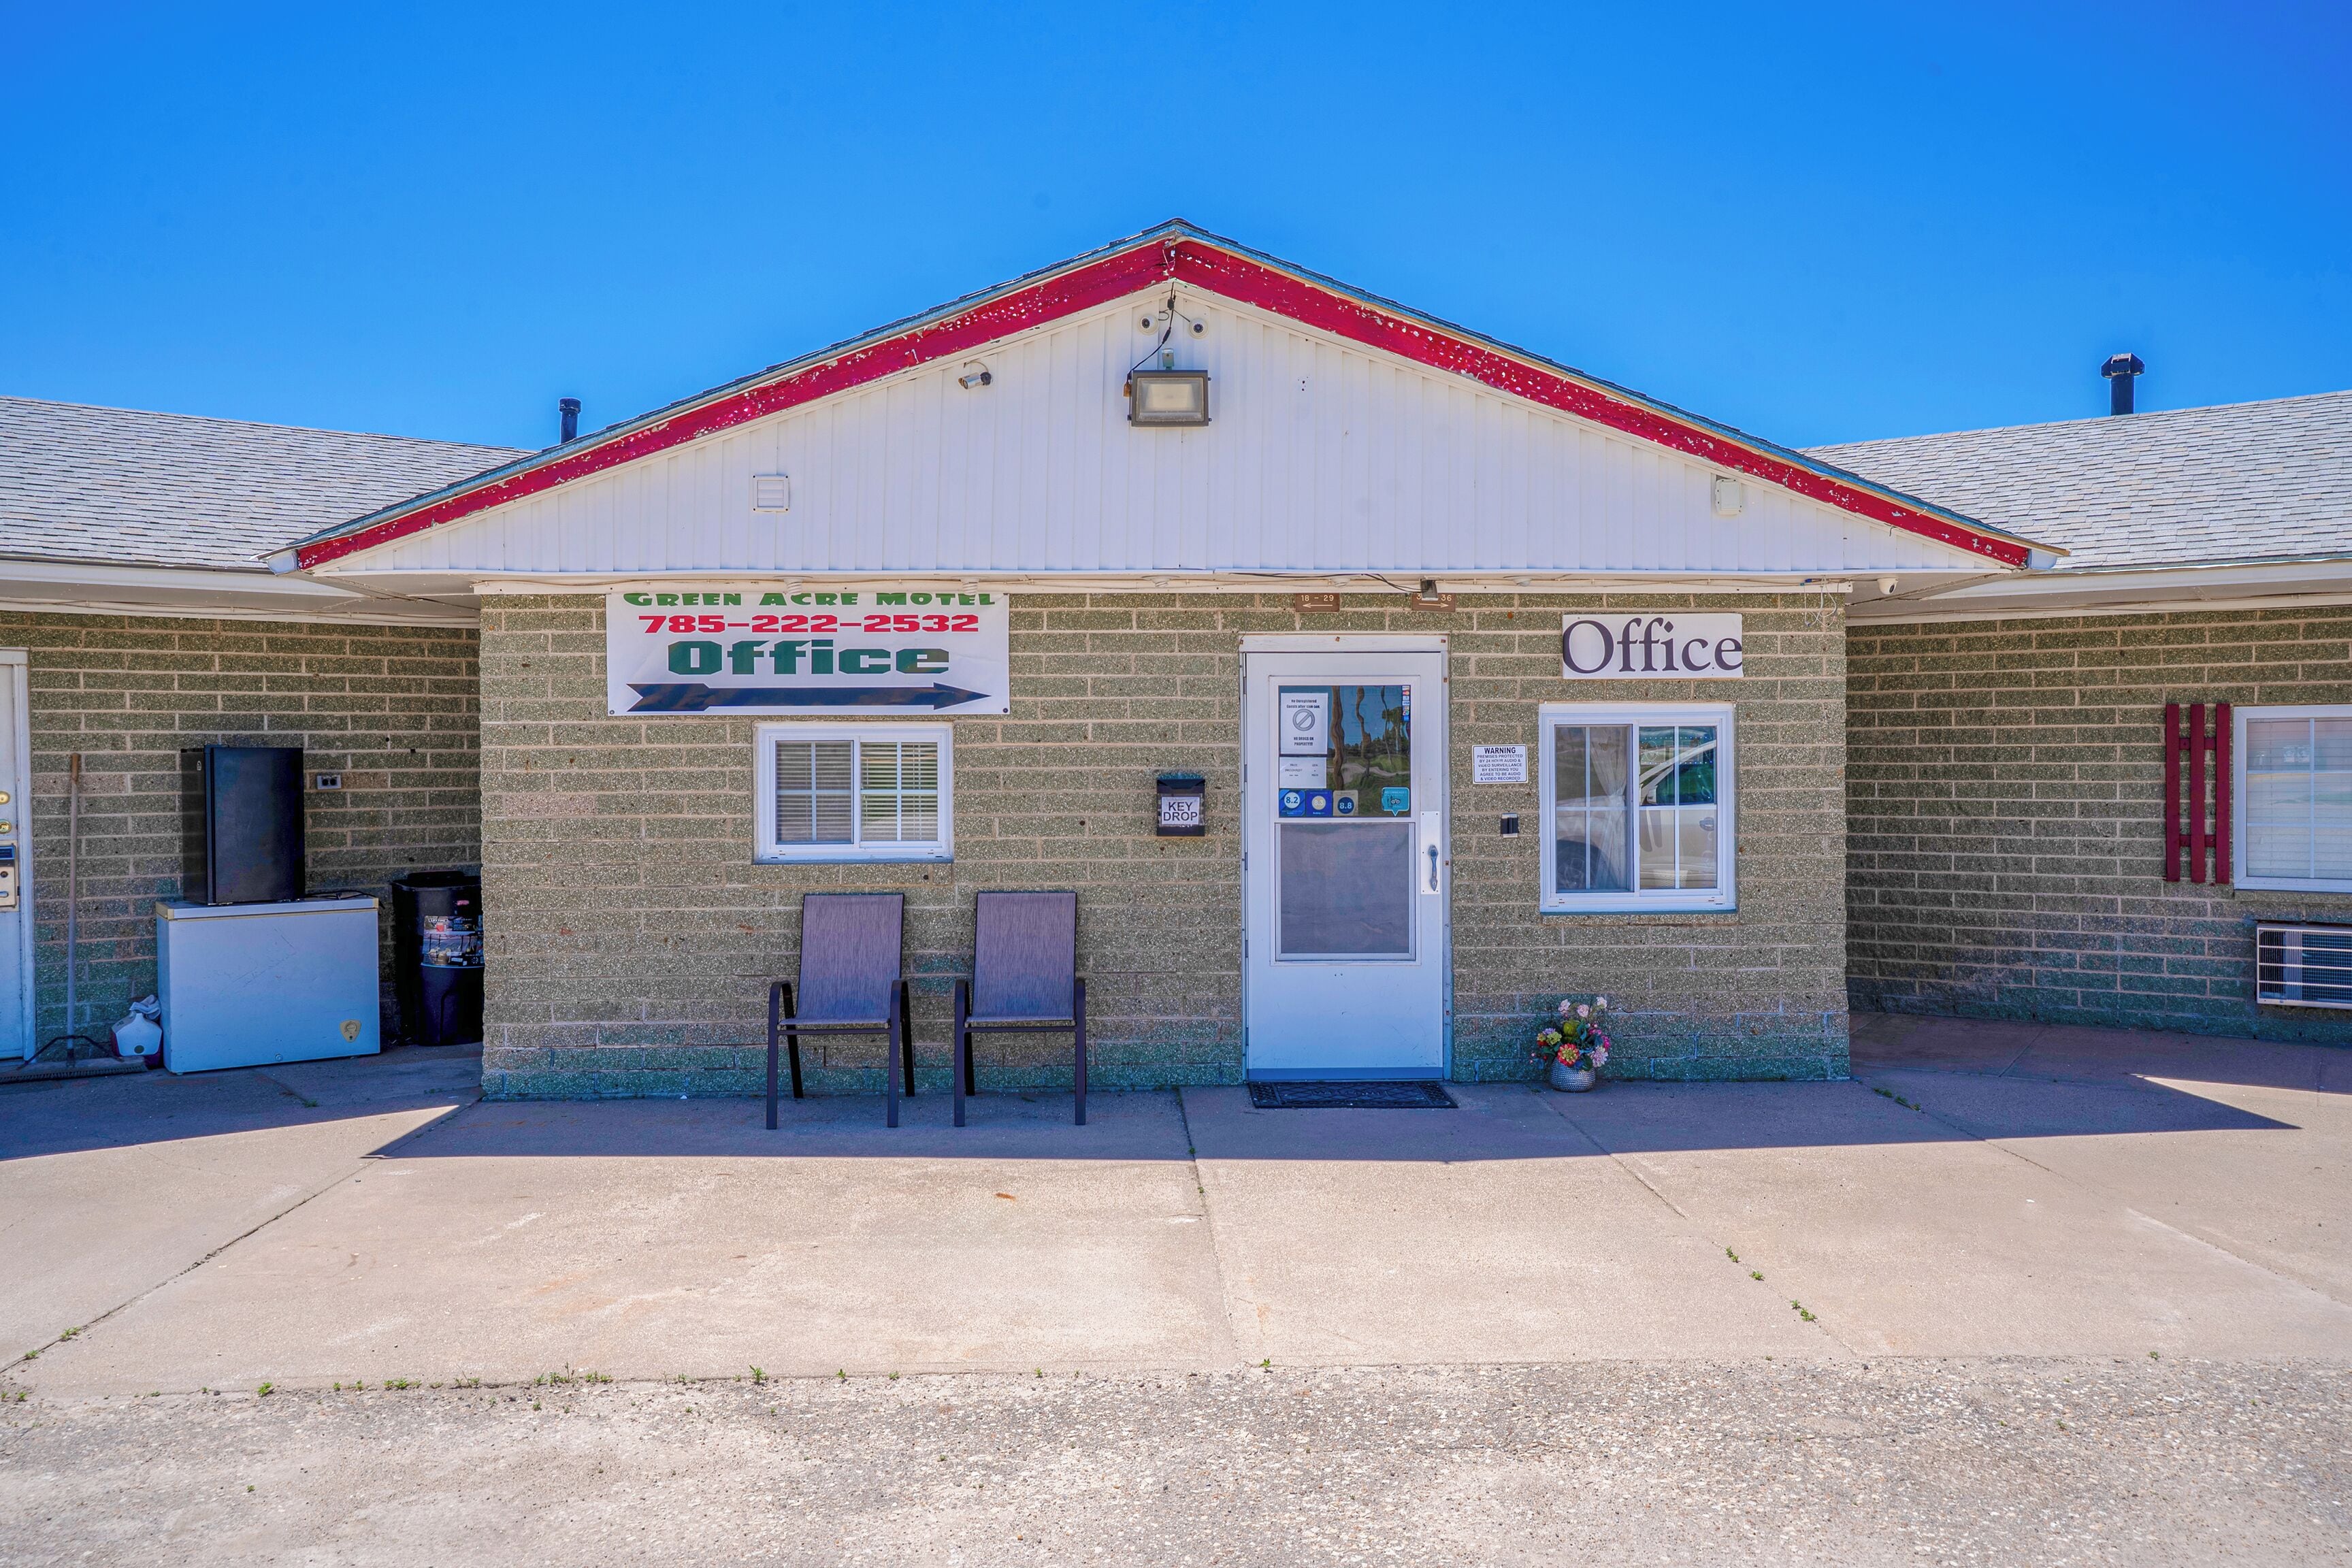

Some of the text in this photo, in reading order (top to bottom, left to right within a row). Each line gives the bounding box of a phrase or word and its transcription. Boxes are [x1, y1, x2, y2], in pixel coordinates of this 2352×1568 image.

[623, 592, 995, 606] GREEN ACRE MOTEL
[639, 615, 979, 634] 785-222-2532
[1563, 617, 1742, 674] Office
[668, 640, 949, 675] Office
[1169, 802, 1192, 811] KEY
[1163, 812, 1198, 821] DROP
